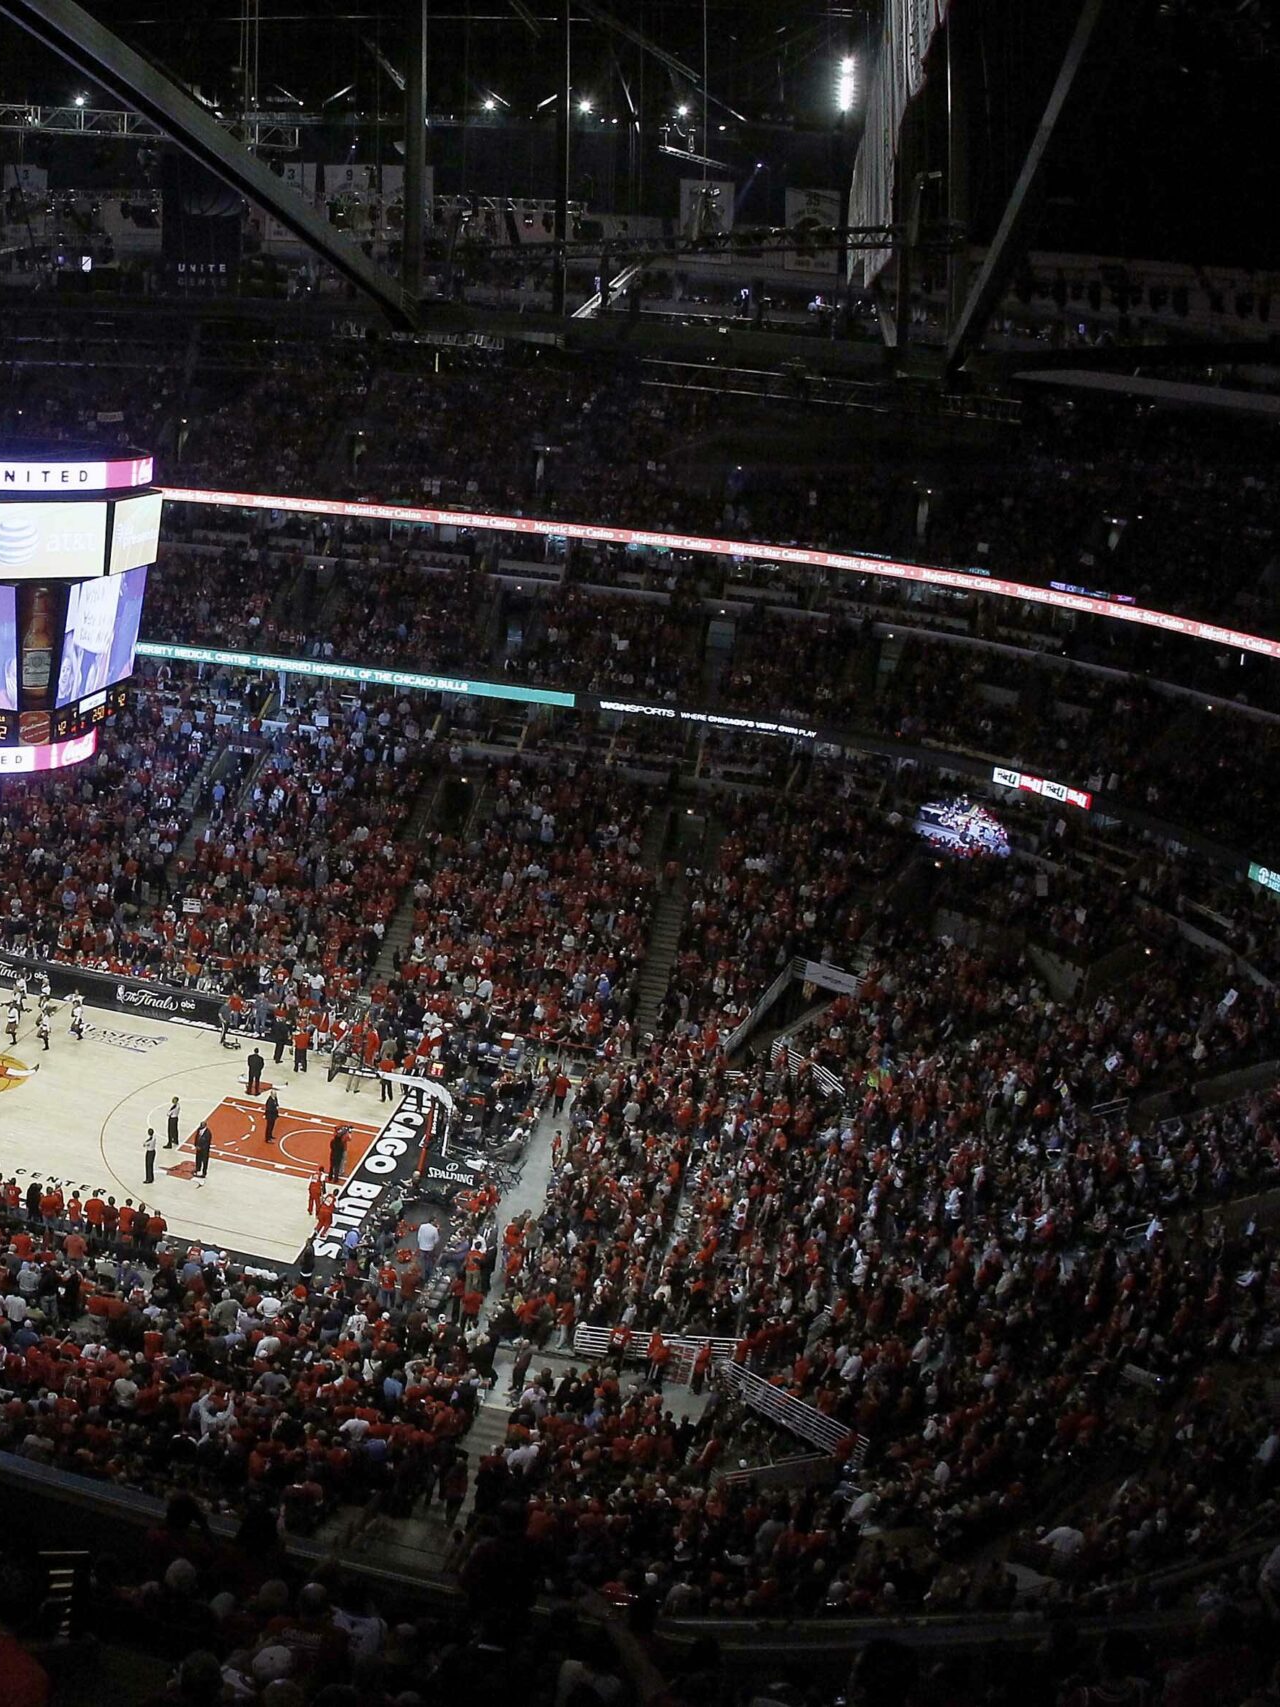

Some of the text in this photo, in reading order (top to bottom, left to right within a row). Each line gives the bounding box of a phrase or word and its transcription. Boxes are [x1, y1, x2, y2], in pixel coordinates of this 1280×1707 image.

[178, 264, 227, 273] UNITE
[177, 277, 227, 287] CENTE
[345, 504, 421, 519] Majestic Star Casino
[438, 513, 517, 529] Majestic Star Casino
[534, 522, 614, 539] Majestic Star Casino
[631, 532, 712, 549] Majestic Star Casino
[730, 543, 810, 561] Majestic Star Casino
[827, 556, 905, 575] Majestic Star Casino
[923, 571, 1001, 591] Majestic Star Casino
[1017, 586, 1049, 600] Majestic
[1050, 591, 1066, 603] Star
[1067, 594, 1093, 609] Casino
[1109, 604, 1184, 630] Majestic Star Casino
[1198, 624, 1272, 652] Majestic Star Casino
[135, 643, 170, 653] VERSITY
[175, 646, 213, 660] MEDICAL
[215, 652, 251, 665] CENTER
[257, 657, 312, 672] PREFERRED
[313, 664, 357, 677] HOSPITAL
[359, 670, 370, 678] OF
[374, 671, 392, 681] THE
[393, 674, 437, 687] CHICAGO
[437, 678, 469, 691] BULLS
[600, 701, 676, 718] WGNSPORTS
[681, 711, 817, 738] WHERE CHICAGO'S VERY OWN PLAY
[34, 970, 48, 980] abc
[123, 989, 179, 1011] The Finals
[180, 1000, 196, 1010] abc
[15, 1168, 108, 1196] CENTER
[427, 1167, 474, 1186] SPALDING
